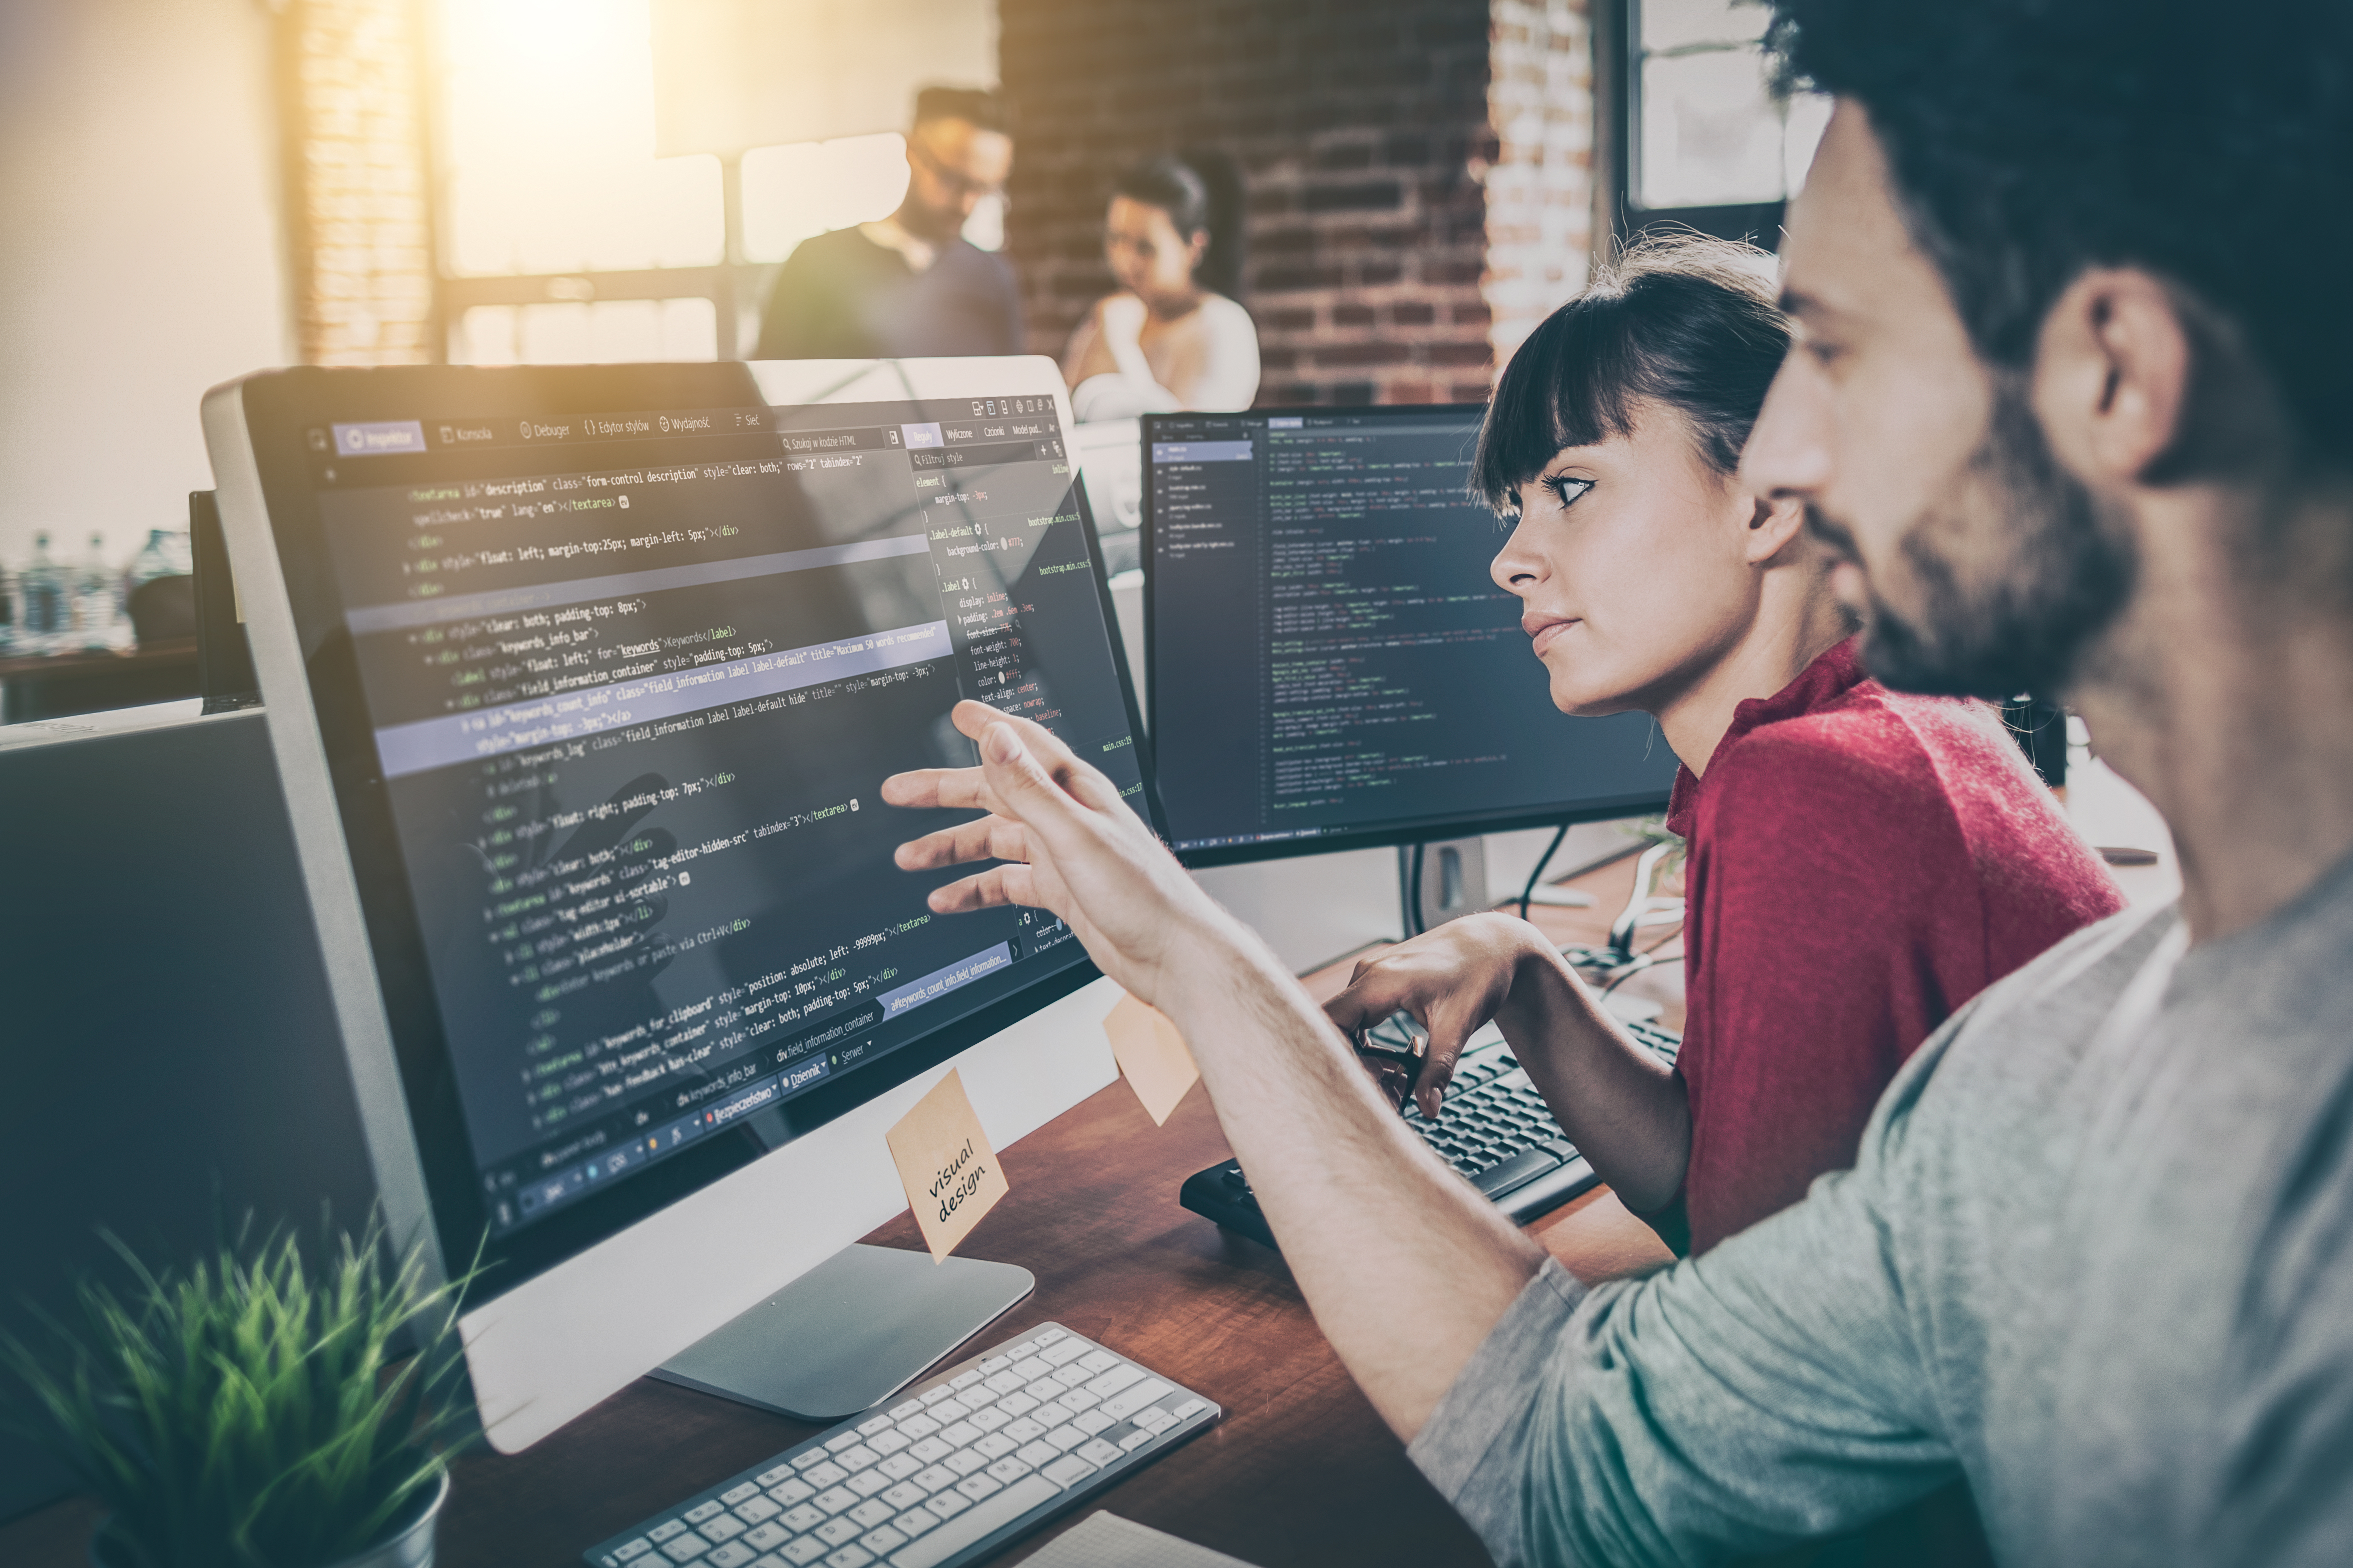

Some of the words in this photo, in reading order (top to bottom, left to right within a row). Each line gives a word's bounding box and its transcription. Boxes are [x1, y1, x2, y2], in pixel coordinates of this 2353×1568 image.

[599, 422, 624, 435] Edytor
[625, 420, 649, 434] stylów
[671, 417, 710, 431] Wydajność
[746, 414, 760, 426] Sieć
[457, 427, 492, 441] Konsola
[534, 424, 570, 441] Debuger
[914, 432, 932, 443] Reguły
[946, 429, 973, 441] Wyliczone
[984, 427, 1005, 437] Czcionki
[1013, 425, 1028, 435] Model
[792, 438, 812, 451] Szukaj
[813, 439, 819, 448] w
[819, 437, 838, 448] kodzie
[839, 436, 857, 447] HTML
[921, 453, 945, 465] Filtruj
[947, 452, 963, 463] style
[553, 472, 644, 491] class="form-control
[647, 468, 699, 483] description"
[704, 465, 757, 480] style="clear:
[760, 461, 783, 474] both;"
[787, 458, 817, 471] rows="2"
[820, 455, 863, 469] tabindex="2"
[1052, 463, 1069, 474] inline
[916, 477, 940, 488] element
[935, 491, 970, 505] margin-top:
[972, 490, 988, 502] -3px;
[1028, 511, 1081, 527] bootstrap.min.css:5
[930, 526, 974, 541] .label-default
[517, 547, 545, 562] left;
[548, 538, 627, 558] margin-top:25px;
[630, 531, 685, 549] margin-left:
[688, 525, 740, 542] 5px;"></div>
[947, 541, 1000, 557] background-color:
[1008, 537, 1024, 547] #777;
[1039, 559, 1092, 576] bootstrap.min.css:5
[942, 580, 961, 593] .label
[959, 597, 985, 609] display:
[987, 592, 1009, 603] inline;
[522, 614, 551, 629] both;
[554, 605, 614, 626] padding-top:
[617, 598, 647, 615] 8px;">
[963, 612, 989, 626] padding:
[991, 609, 1004, 619] .2em
[1006, 606, 1019, 616] .6em
[1021, 603, 1035, 614] .3em;
[966, 627, 998, 640] font-size:
[970, 641, 1008, 656] font-weight:
[1009, 637, 1022, 648] 700;
[562, 649, 593, 666] left;"
[663, 643, 745, 671] style="padding-top:
[748, 639, 774, 655] 5px;">
[616, 670, 725, 702] class="field_information
[728, 663, 750, 679] label
[752, 651, 808, 674] label-default"
[811, 642, 864, 662] title="Maximum
[865, 639, 874, 649] 50
[876, 635, 895, 648] words
[897, 626, 937, 643] recommended"
[974, 656, 1011, 672] line-height:
[978, 676, 997, 688] color:
[707, 709, 730, 725] label
[733, 698, 787, 719] label-default
[789, 691, 808, 705] hide"
[846, 671, 910, 694] style="margin-top:
[912, 664, 936, 678] -3px;">
[981, 687, 1016, 704] text-align:
[1017, 682, 1039, 695] center;
[1023, 697, 1045, 709] nowrap;
[1035, 708, 1062, 722] baseline;
[1103, 736, 1132, 752] main.css:19
[587, 802, 619, 820] right;
[622, 787, 679, 812] padding-top:
[682, 773, 736, 796] 7px;"></div>
[1118, 782, 1143, 798] in.css:17
[753, 802, 849, 839] tabindex="3"></textarea>
[1018, 918, 1023, 926] a
[1036, 925, 1055, 938] color:
[651, 945, 677, 964] paste
[679, 937, 695, 951] via
[697, 918, 751, 945] Ctrl+V</div>
[718, 971, 788, 1005] style="position:
[790, 954, 827, 976] absolute;
[829, 946, 850, 961] left:
[714, 989, 792, 1029] style="margin-top:
[794, 967, 847, 997] 10px;"></div>
[719, 1018, 776, 1050] style="clear:
[778, 1008, 801, 1025] both;
[803, 987, 851, 1015] padding-top:
[853, 967, 898, 992] 5px;"></div>
[777, 1010, 874, 1063] div.field_information_container
[841, 1043, 864, 1065] Serwer
[790, 1063, 821, 1089] Dziennik
[930, 1138, 974, 1198] visual
[939, 1165, 986, 1223] design
